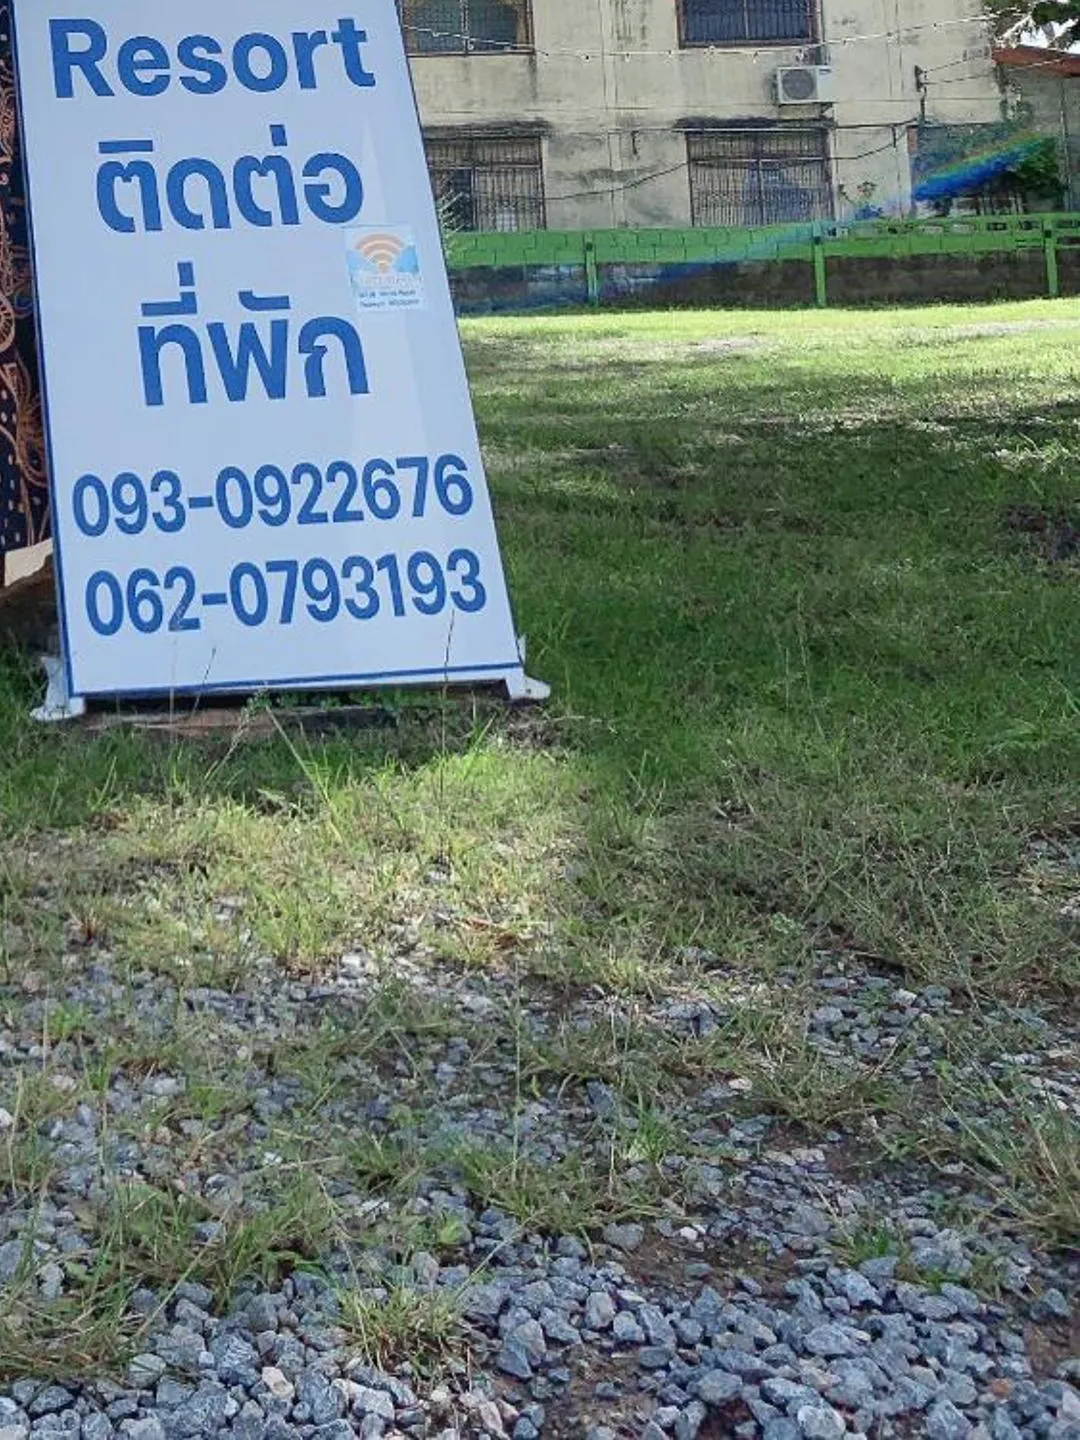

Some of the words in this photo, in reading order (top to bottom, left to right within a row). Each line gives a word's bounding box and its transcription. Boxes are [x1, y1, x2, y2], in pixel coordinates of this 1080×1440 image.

[48, 18, 376, 98] Resort
[96, 124, 364, 233] ติดต่อ
[137, 262, 370, 406] ที่พัก
[72, 454, 474, 537] 093-0922676
[85, 548, 487, 636] 062-0793193
